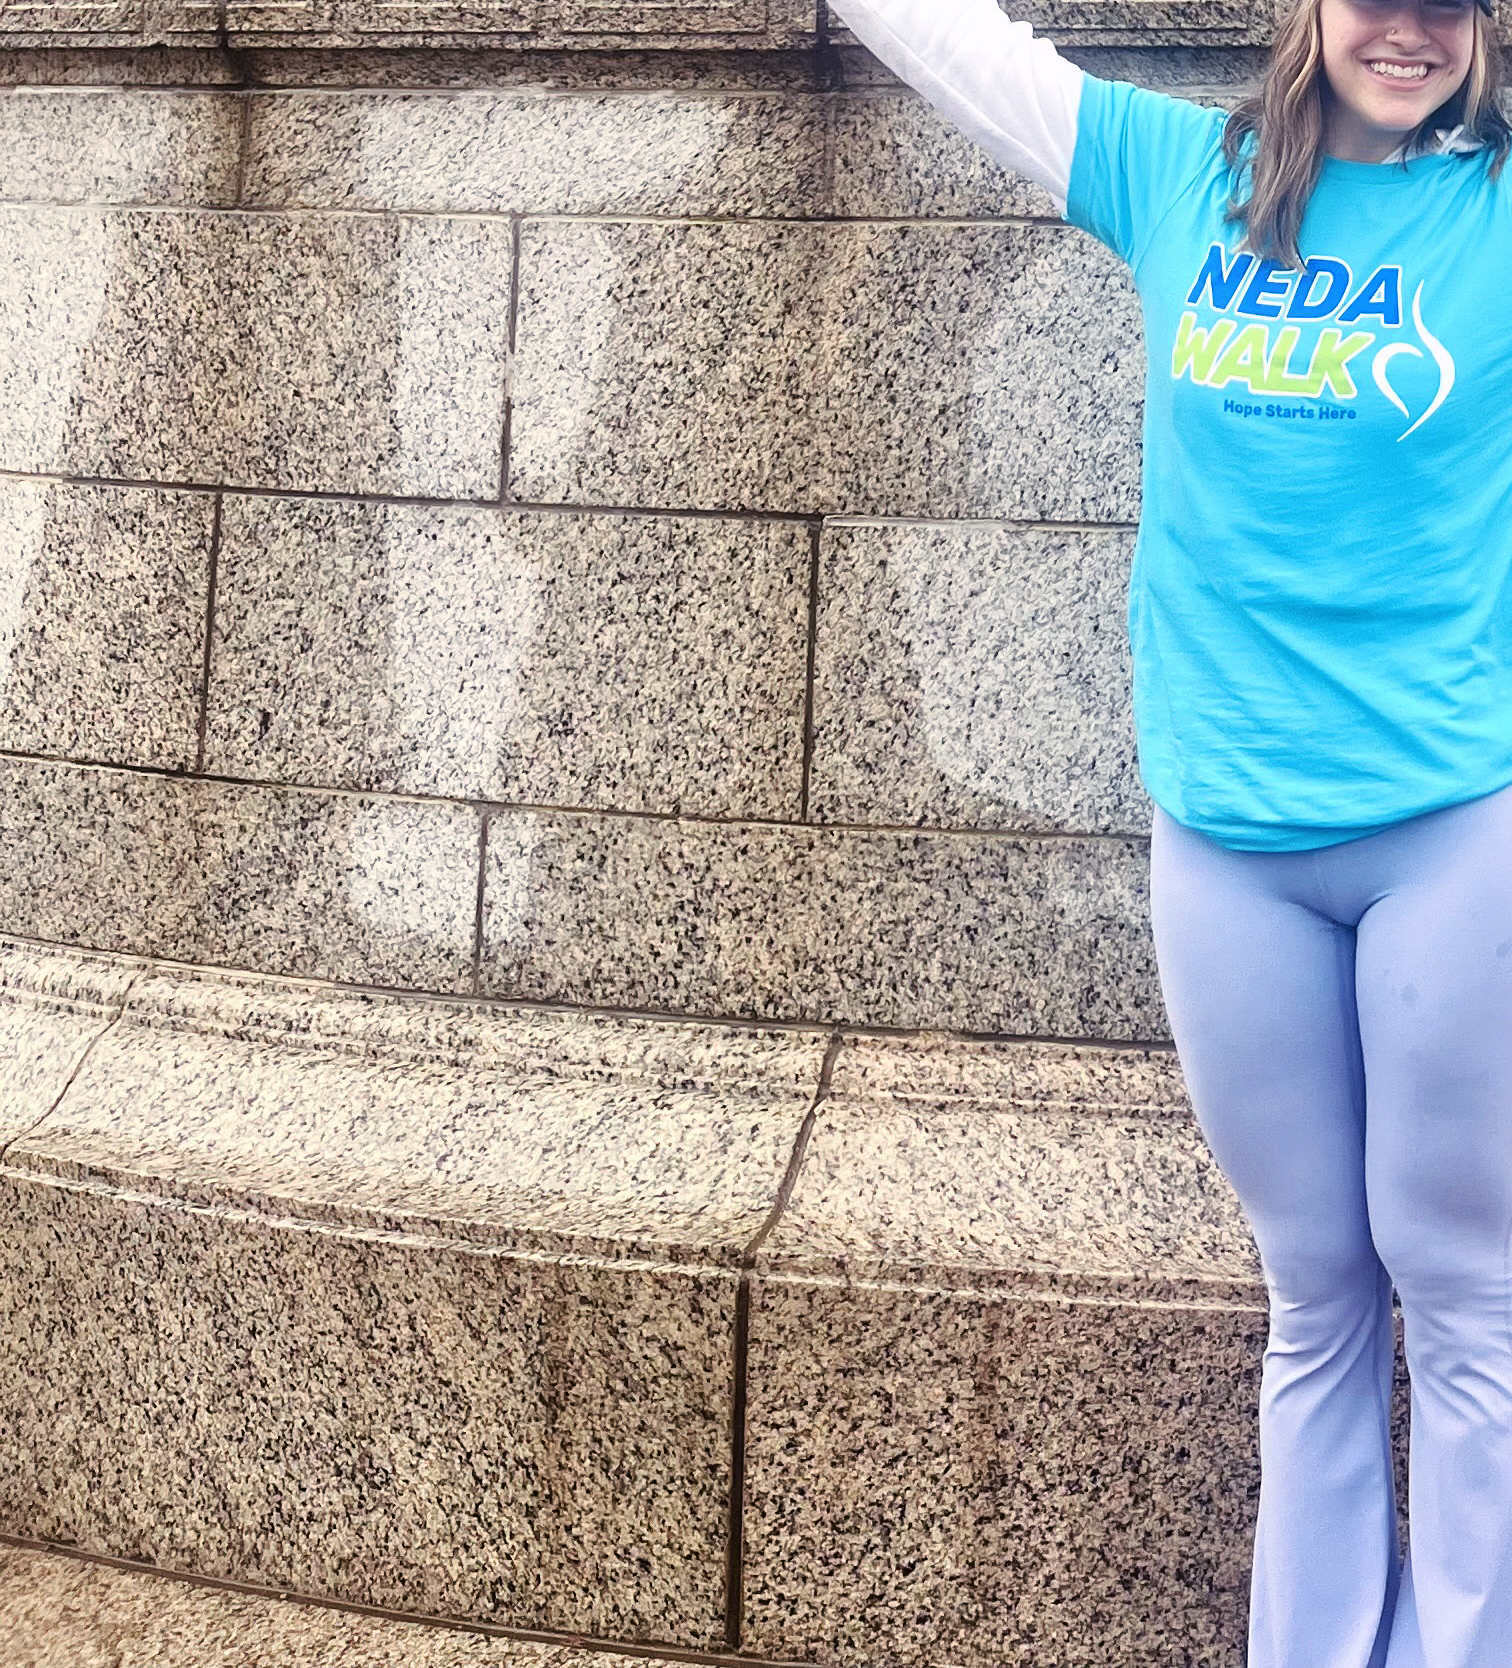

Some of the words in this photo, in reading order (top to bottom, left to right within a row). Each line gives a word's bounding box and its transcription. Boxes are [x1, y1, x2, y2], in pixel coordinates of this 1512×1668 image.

[1185, 241, 1403, 329] NEDA
[1171, 310, 1377, 400] WALK
[1223, 399, 1262, 418] Hope
[1265, 404, 1315, 419] Starts
[1318, 406, 1357, 420] Here
